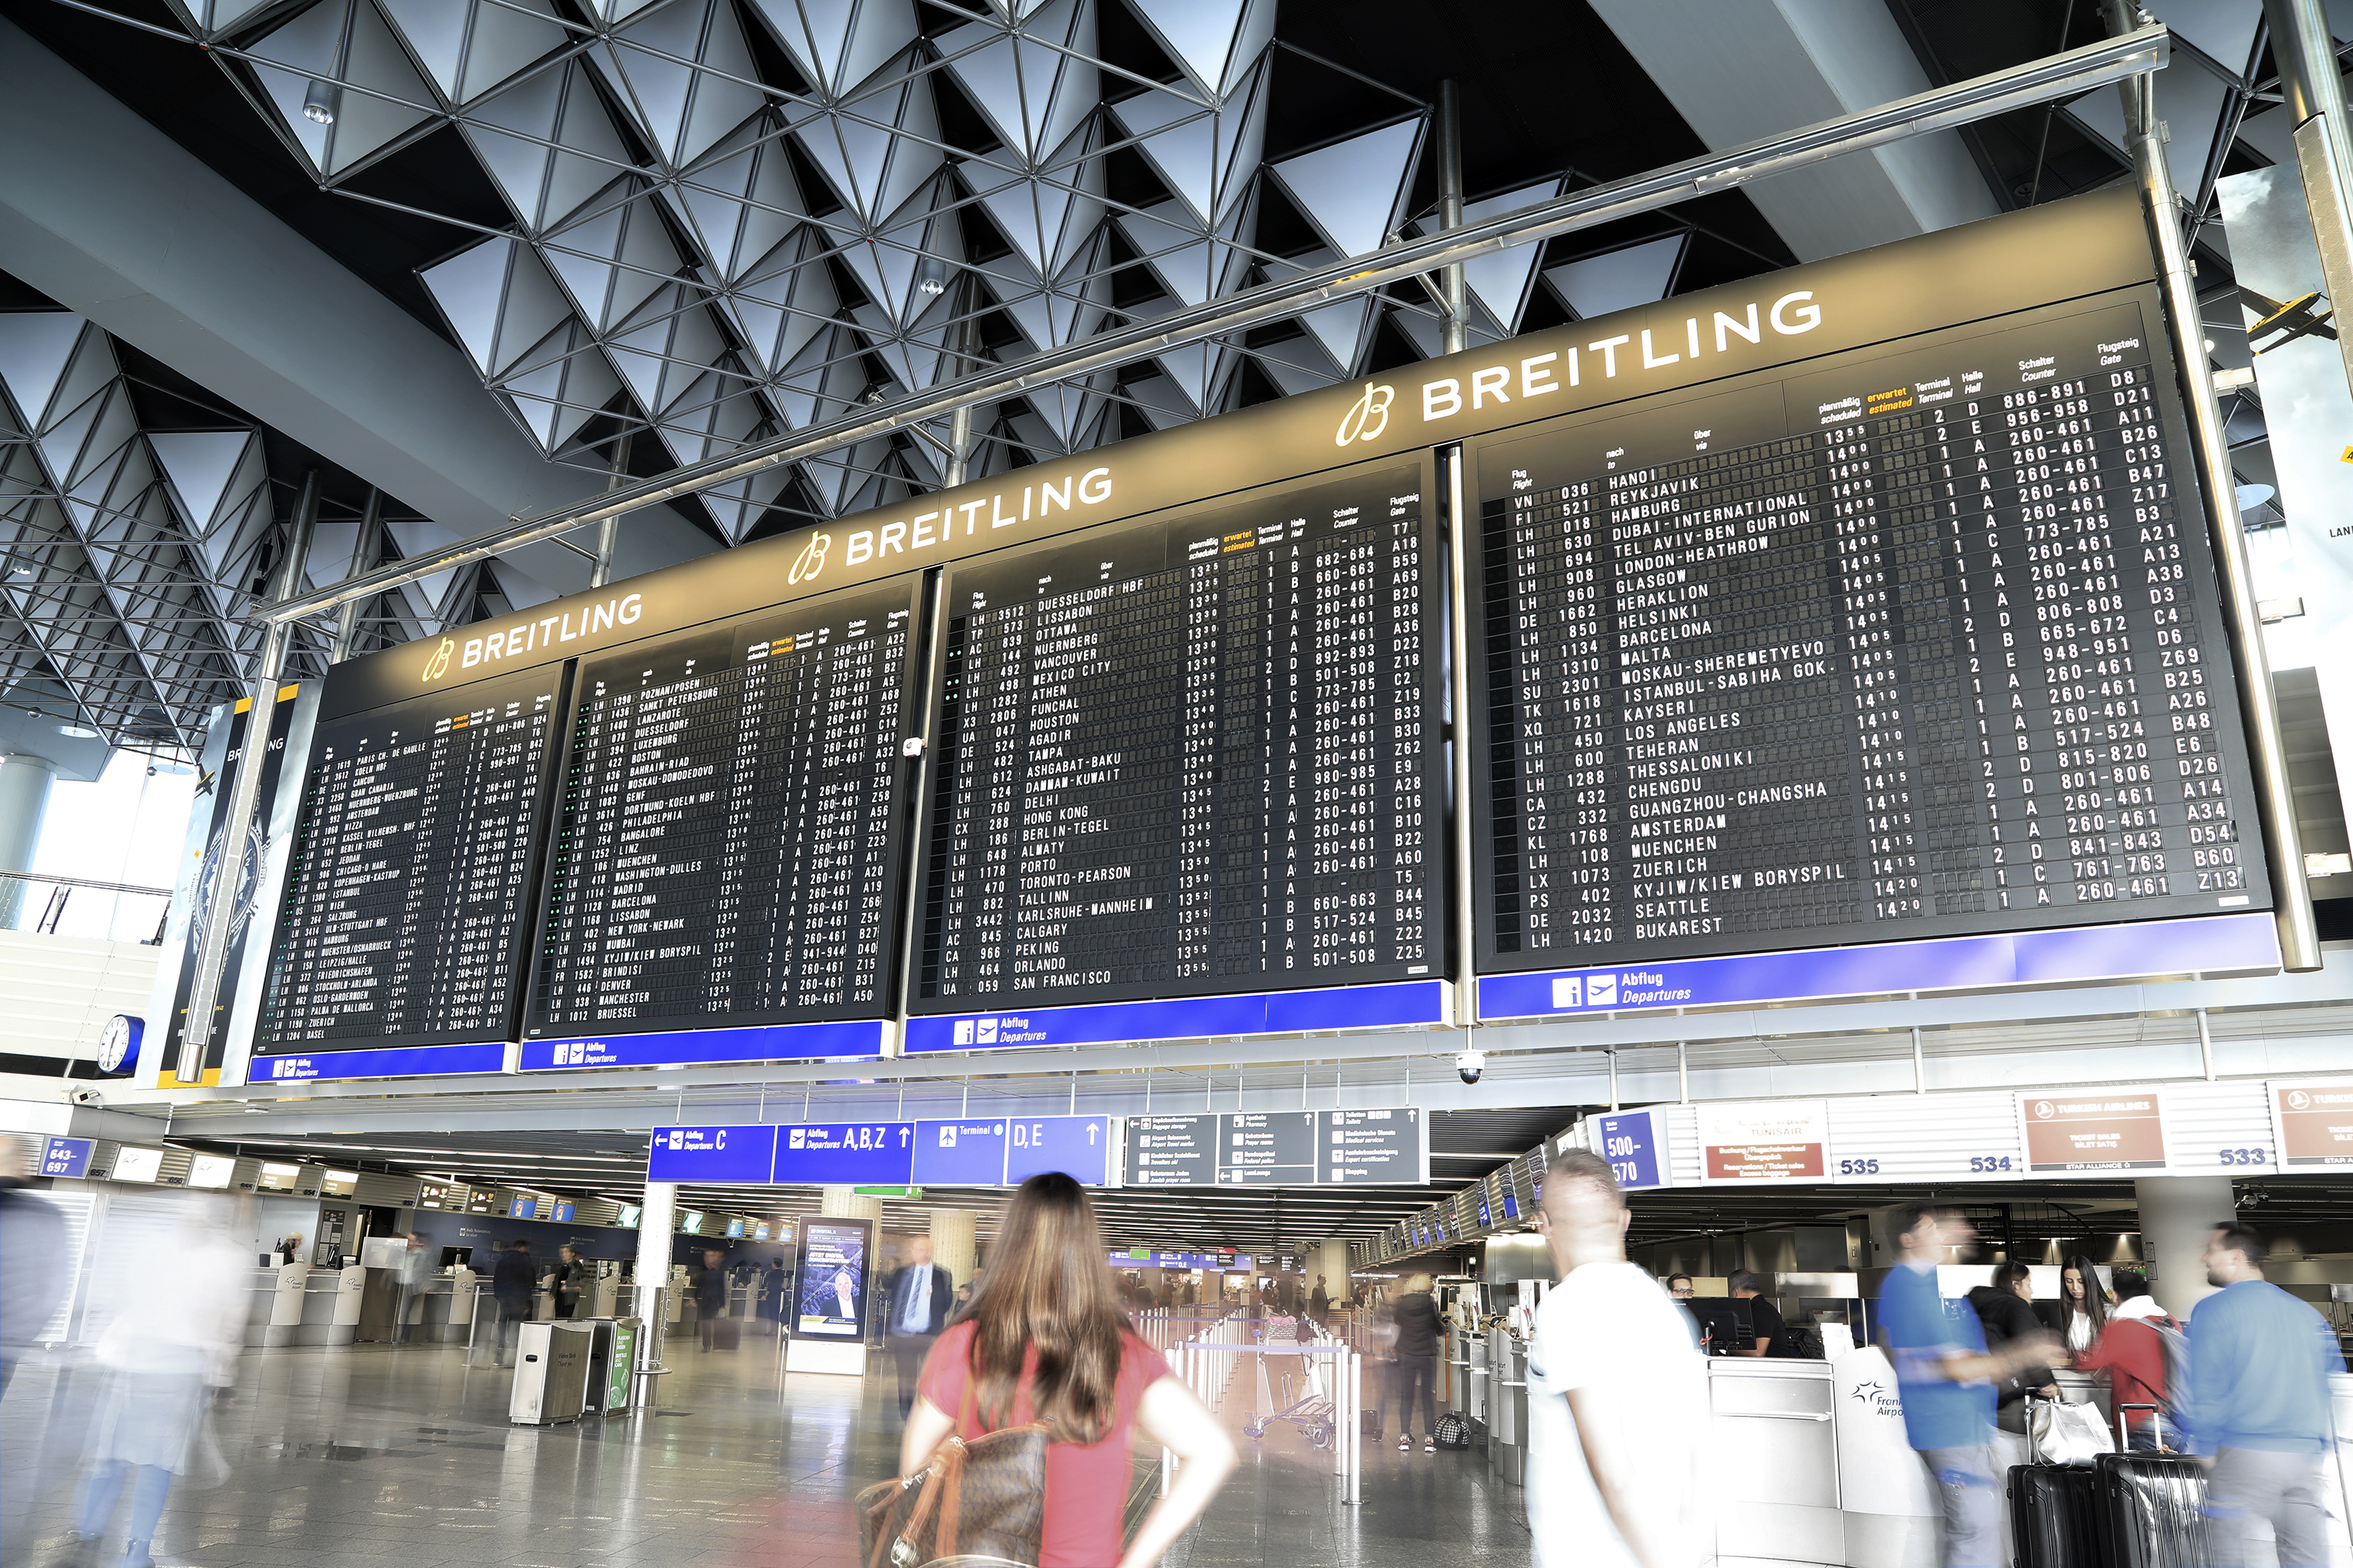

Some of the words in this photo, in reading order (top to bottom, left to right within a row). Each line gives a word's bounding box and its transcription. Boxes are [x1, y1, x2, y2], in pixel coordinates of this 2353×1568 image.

[2097, 337, 2139, 355] Flugsteig
[1423, 291, 1821, 421] BREITLING
[2018, 355, 2055, 370] Schalter
[2100, 353, 2122, 365] Gate
[1961, 371, 1983, 383] Halle
[2021, 367, 2056, 382] Counter
[1915, 377, 1950, 392] Terminal
[1965, 382, 1981, 394] Hall
[1867, 386, 1907, 403] erwartet
[1918, 388, 1953, 404] Terminal
[1818, 396, 1860, 414] planmäßig
[1869, 397, 1912, 414] estimated
[1820, 408, 1862, 424] scheduled
[1515, 495, 1532, 509] VN
[1562, 483, 1588, 499] 036
[1609, 469, 1655, 489] HANOI
[2111, 371, 2134, 387] D8
[1694, 428, 1711, 440] über
[1606, 447, 1624, 459] nach
[1696, 441, 1707, 451] via
[1516, 512, 1530, 525] FI
[1563, 500, 1588, 516] 521
[1611, 477, 1699, 506] REYKJAVIK
[2007, 399, 2088, 427] 956-958
[2114, 387, 2148, 406] D21
[1607, 460, 1616, 470] to
[1512, 469, 1527, 480] Flug
[1513, 478, 1532, 490] Flight
[846, 467, 1112, 566] BREITLING
[1611, 499, 1680, 523] HAMBURG
[1613, 493, 1807, 541] DUBAI-INTERNATIONAL
[1614, 542, 1641, 558] TEL
[1654, 524, 1735, 551] AVIV-BEN
[1747, 509, 1810, 533] GURION
[1615, 536, 1768, 576] LONDON-HEATHROW
[1520, 614, 1537, 629] DE
[1560, 604, 1595, 621] 1662
[1617, 584, 1708, 612] HERAKLION
[2024, 514, 2109, 541] 773-785
[2135, 506, 2159, 522] B3
[1617, 569, 1686, 594] GLASGOW
[1038, 585, 1114, 612] DUESSELDORF
[1122, 579, 1143, 593] HBF
[1037, 605, 1092, 626] LISSABON
[1619, 604, 1696, 630] HELSINKI
[461, 594, 642, 669] BREITLING
[1036, 623, 1077, 641] OTTAWA
[1620, 620, 1712, 648] BARCELONA
[1034, 649, 1096, 670] VANCOUVER
[1621, 647, 1671, 666] MALTA
[1622, 641, 1823, 685] MOSKAU-SHEREMETYEVO
[1033, 668, 1074, 686] MEXICO
[1083, 660, 1110, 676] CITY
[1625, 667, 1781, 703] ISTANBUL-SABIHA
[1794, 660, 1834, 678] GOK.
[641, 679, 700, 700] POZNAN/POSEN
[1031, 698, 1079, 716] FUNCHAL
[1624, 699, 1693, 722] KAYSERI
[637, 708, 681, 725] LANZAROTE
[1626, 725, 1654, 741] LOS
[1667, 712, 1740, 735] ANGELES
[1029, 729, 1070, 747] AGADIR
[631, 749, 661, 764] BOSTON
[1626, 738, 1699, 760] TEHERAN
[355, 765, 373, 776] KOELN
[375, 762, 387, 771] HBF
[1027, 752, 1120, 778] ASHGABAT-BAKU
[1627, 751, 1752, 779] THESSALONIKI
[1629, 777, 1701, 799] CHENGDU
[1025, 794, 1058, 809] DELHI
[1630, 782, 1827, 819] GUANGZHOU-CHANGSHA
[623, 810, 682, 829] PHILADELPHIA
[1024, 810, 1051, 825] HONG
[1060, 806, 1088, 820] KONG
[344, 820, 362, 831] NIZZA
[1631, 814, 1725, 838] AMSTERDAM
[1021, 841, 1064, 857] ALMATY
[1631, 836, 1716, 858] MUENCHEN
[1633, 857, 1706, 878] ZUERICH
[1020, 866, 1130, 889] TORONTO-PEARSON
[1634, 874, 1742, 899] KYJIW/KIEW
[1755, 864, 1844, 886] BORYSPIL
[333, 887, 360, 899] ISTANBUL
[610, 908, 650, 922] LISSABON
[1018, 897, 1152, 922] KARLSRUHE-MANNHEIM
[1636, 898, 1709, 918] SEATTLE
[1636, 918, 1722, 939] BUKAREST
[1016, 941, 1059, 956] PEKING
[602, 964, 641, 977] BRINDISI
[1621, 971, 1663, 987] Abflug
[601, 980, 631, 991] DENVER
[1014, 977, 1035, 990] SAN
[1044, 971, 1110, 987] FRANCISCO
[1622, 989, 1692, 1005] Departures
[309, 1017, 335, 1027] ZUERICH
[598, 1007, 637, 1020] BRUESSEL
[1001, 1016, 1029, 1031] Abflug
[306, 1030, 324, 1039] BASEL
[1000, 1031, 1046, 1044] Departures
[585, 1042, 606, 1053] Abflug
[585, 1054, 617, 1064] Departures
[2056, 1102, 2101, 1115] TURKISH
[2103, 1101, 2151, 1112] AIRLINES
[807, 1128, 828, 1140] Abflug
[843, 1127, 886, 1151] A,B,Z
[959, 1125, 990, 1136] Terminal
[1013, 1123, 1043, 1149] D,E
[1752, 1127, 1801, 1136] TUNISAIR
[2069, 1133, 2094, 1142] TICKET
[2096, 1132, 2121, 1141] SALES
[684, 1131, 703, 1141] Abflug
[716, 1130, 727, 1151] C
[684, 1141, 713, 1151] Departures
[806, 1140, 841, 1150] Departures
[1607, 1135, 1641, 1157] 500-
[50, 1149, 77, 1160] 643-
[2220, 1147, 2266, 1166] 533
[47, 1161, 69, 1174] 697
[90, 1168, 107, 1177] 657
[1613, 1161, 1637, 1181] 570
[1840, 1158, 1880, 1175] 535
[1971, 1156, 2012, 1173] 534
